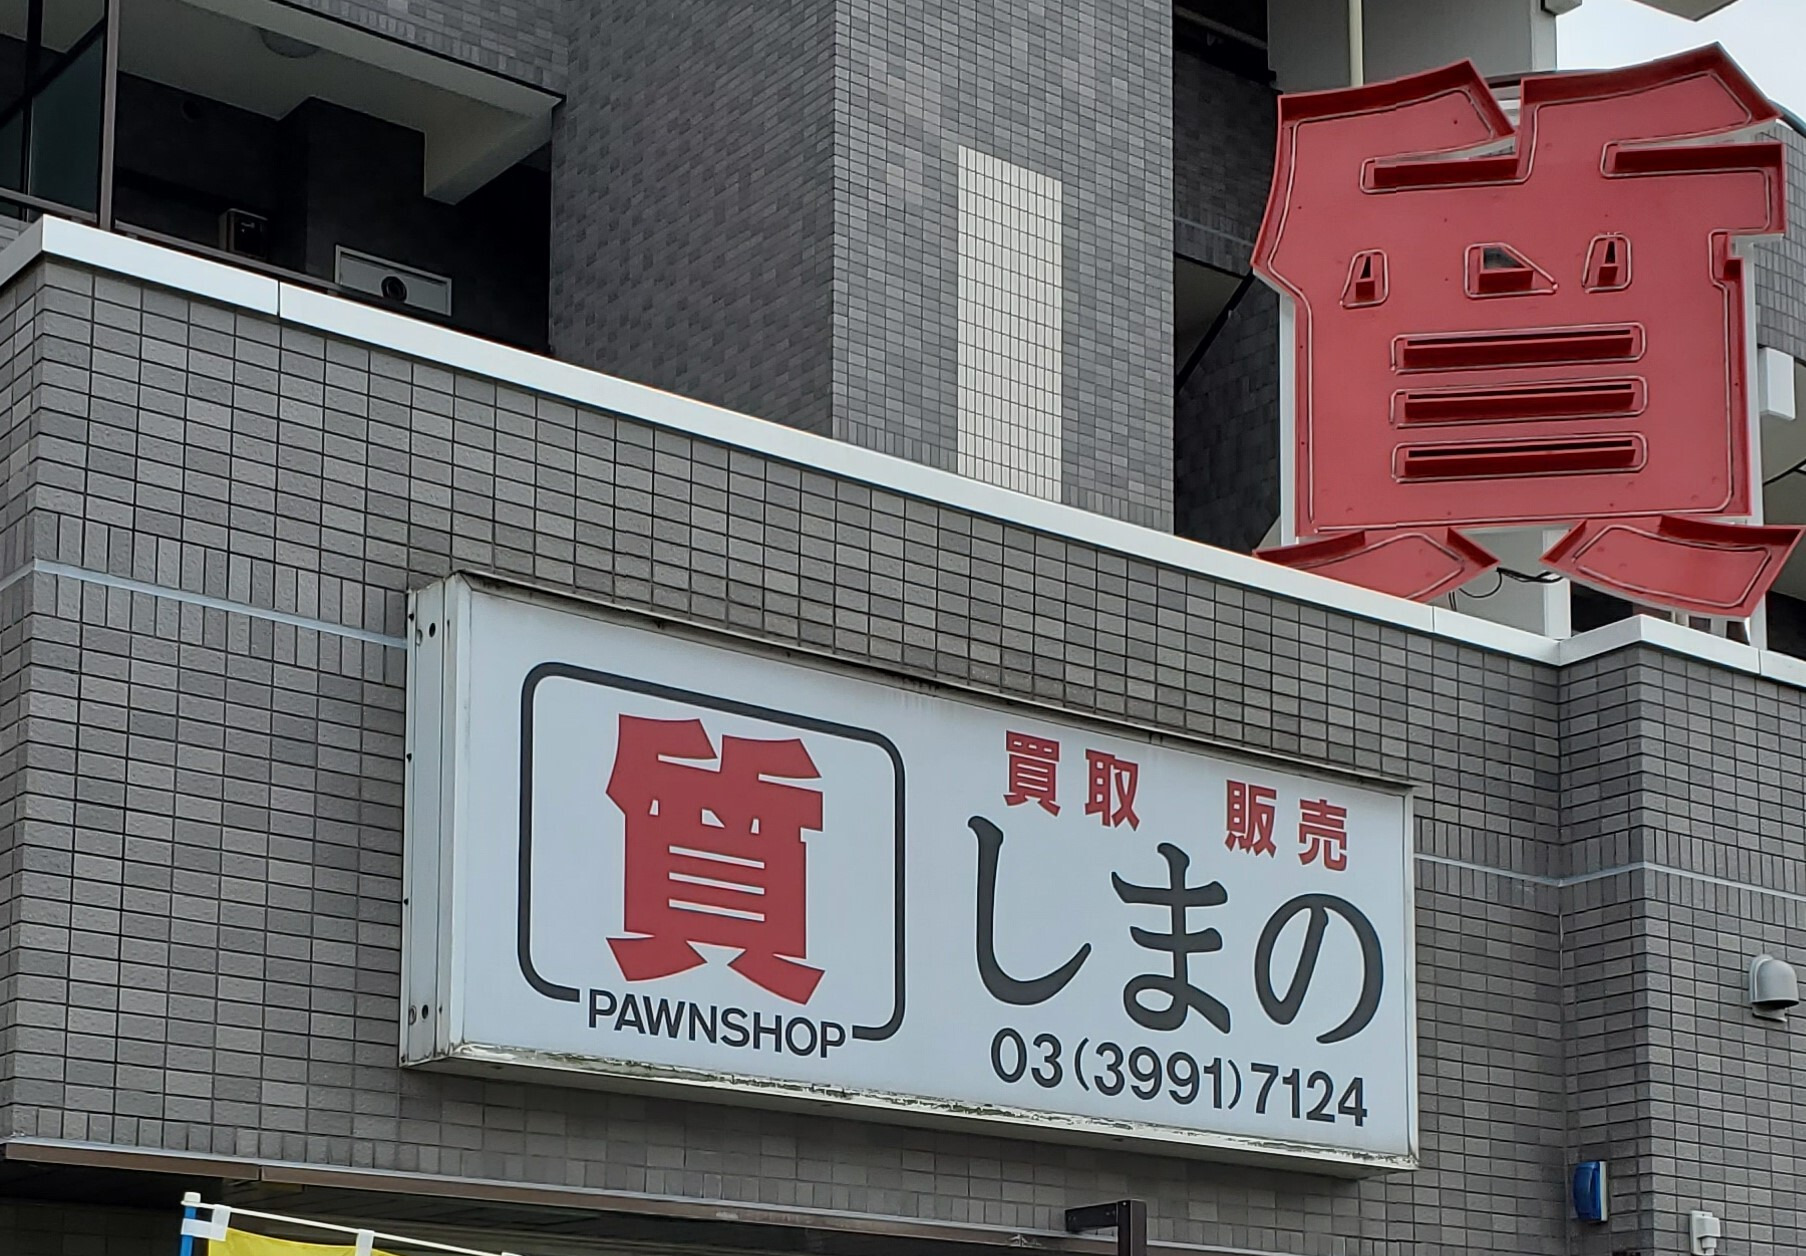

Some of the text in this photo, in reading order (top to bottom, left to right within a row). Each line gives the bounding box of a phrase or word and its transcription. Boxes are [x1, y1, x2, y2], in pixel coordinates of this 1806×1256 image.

[1252, 42, 1805, 617] 質
[606, 713, 825, 1005] 質
[1003, 730, 1348, 872] 買取 販売
[967, 814, 1384, 1044] しまの
[588, 988, 847, 1059] PAWNSHOP
[988, 1027, 1368, 1127] 03(3991)7124
